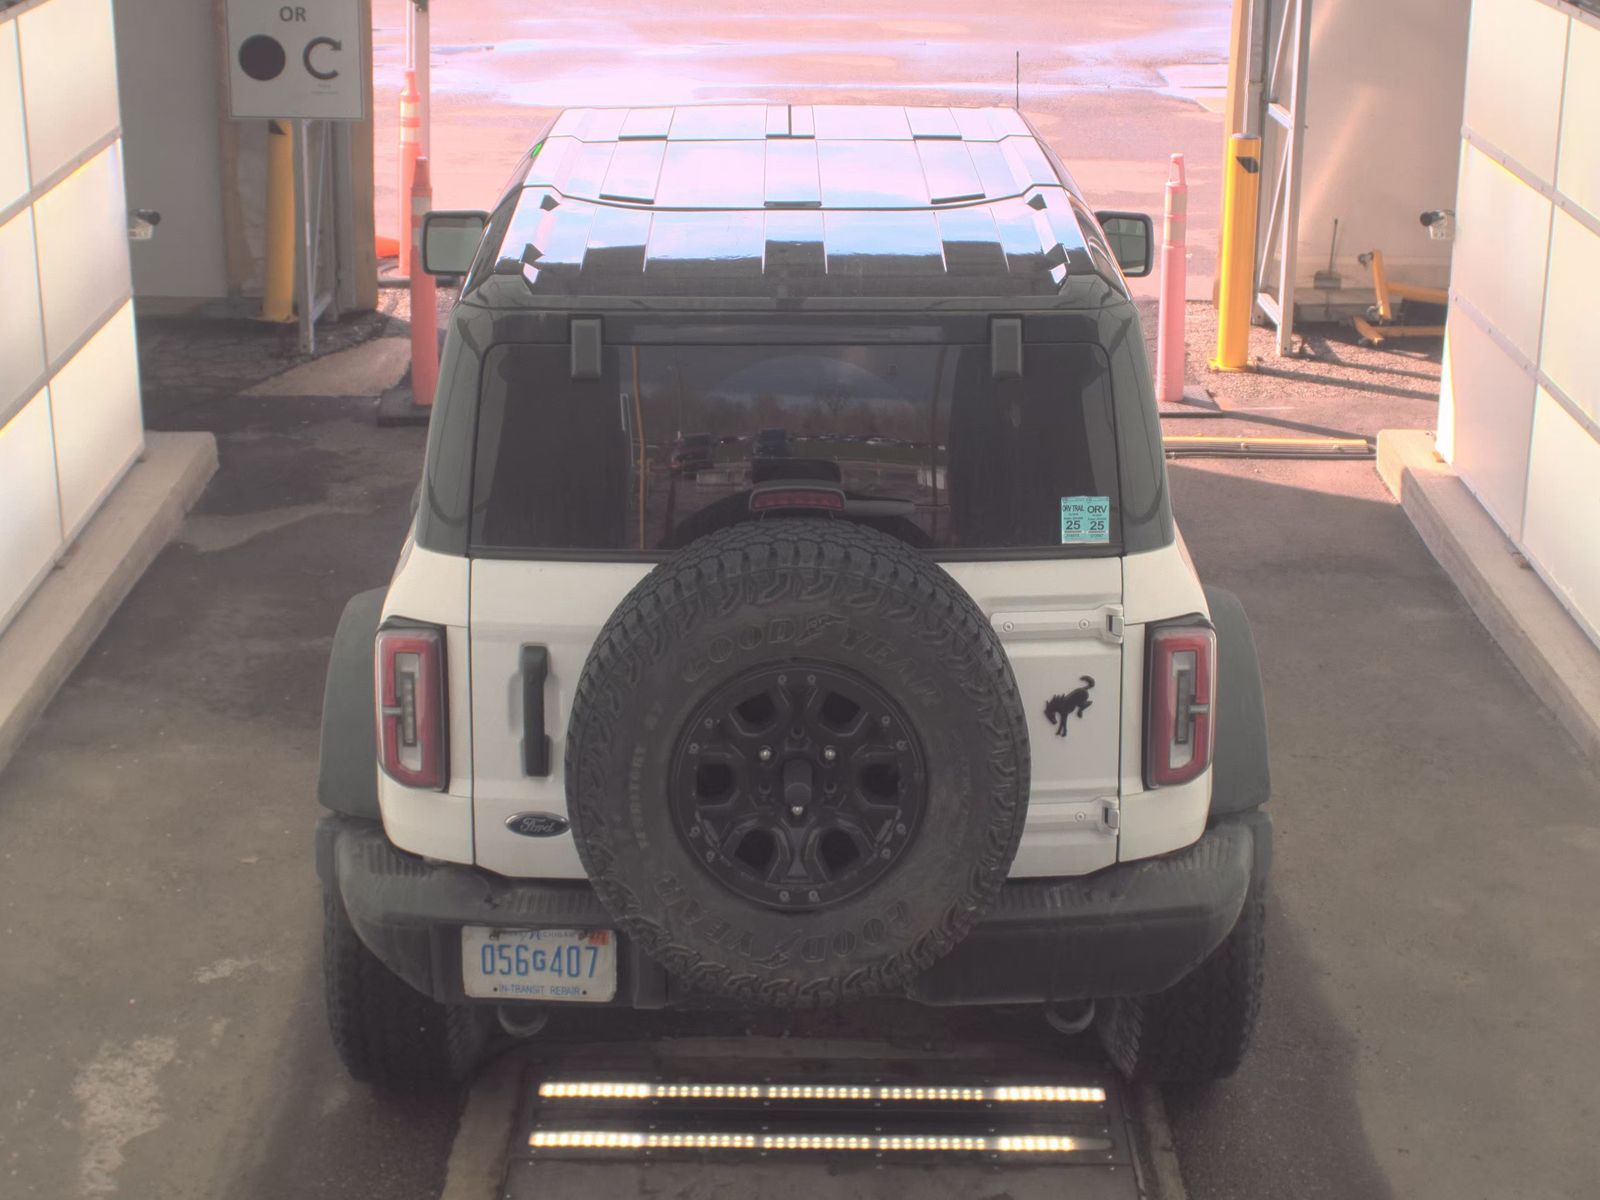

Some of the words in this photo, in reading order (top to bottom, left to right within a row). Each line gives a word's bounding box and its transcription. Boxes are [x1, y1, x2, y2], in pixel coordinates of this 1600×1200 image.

[279, 6, 307, 22] OR
[1087, 505, 1107, 513] ORV
[1066, 520, 1081, 530] 25
[1090, 520, 1104, 530] 25
[520, 816, 557, 833] Ford
[481, 943, 599, 978] 056G407
[550, 986, 581, 996] REPAIR
